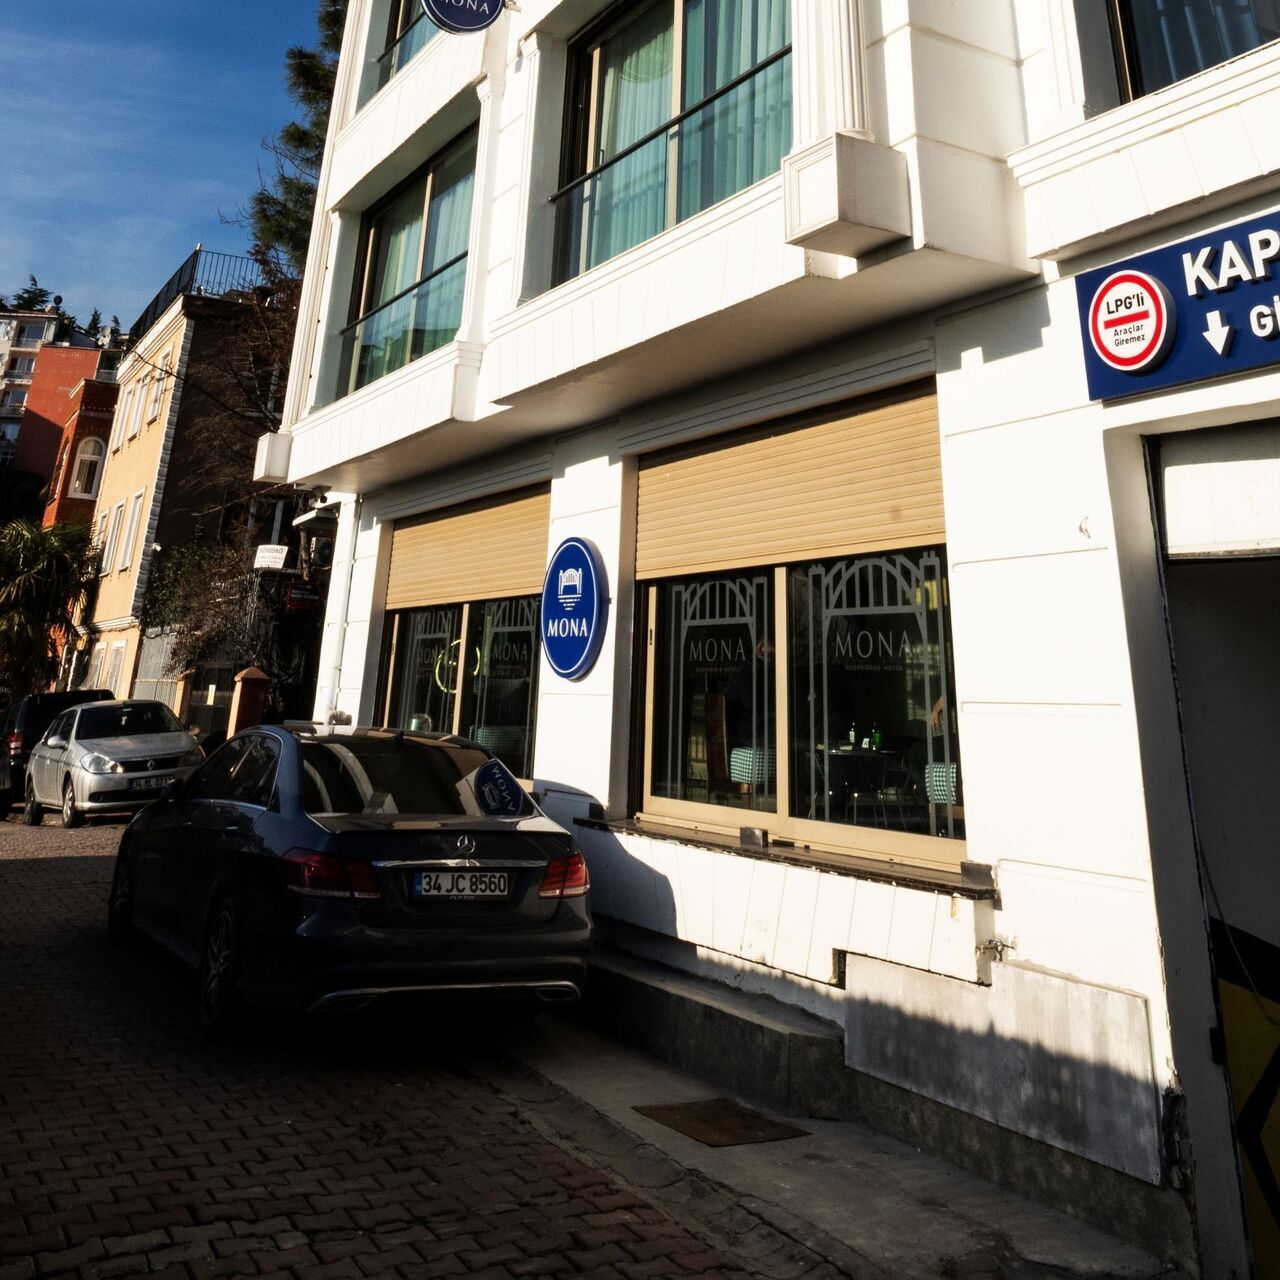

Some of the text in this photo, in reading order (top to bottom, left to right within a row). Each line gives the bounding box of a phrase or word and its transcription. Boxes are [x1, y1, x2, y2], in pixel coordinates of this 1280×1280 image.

[1114, 324, 1144, 337] Araçlar
[1114, 334, 1146, 347] Giremez
[547, 618, 588, 637] MONA
[493, 643, 529, 661] MONA
[689, 638, 746, 662] MONA
[835, 630, 912, 658] MONA
[423, 874, 507, 893] 34 JC 8560
